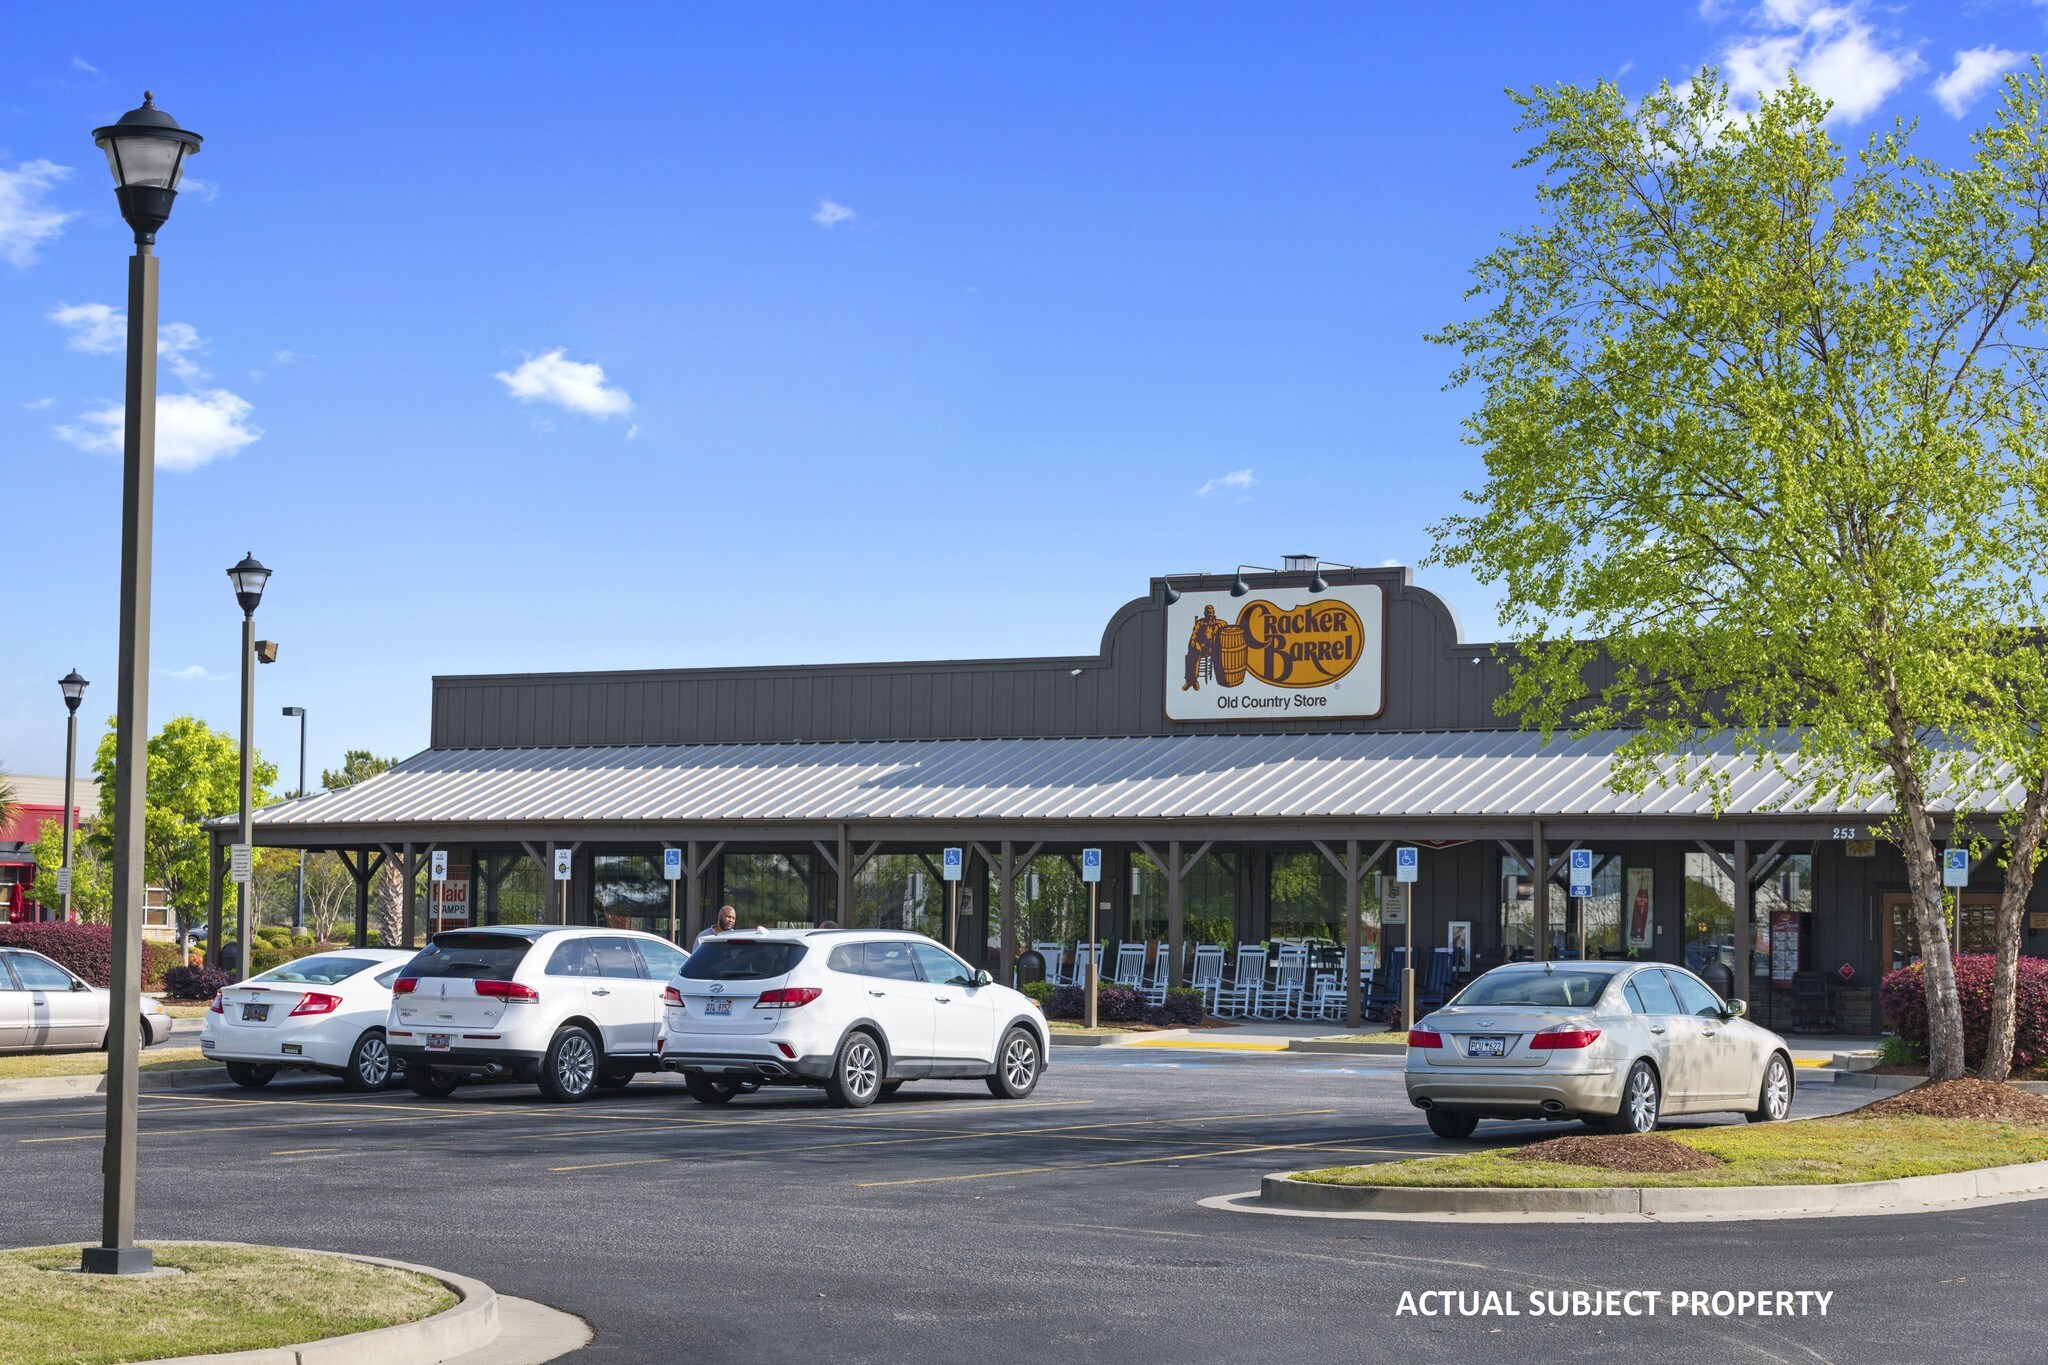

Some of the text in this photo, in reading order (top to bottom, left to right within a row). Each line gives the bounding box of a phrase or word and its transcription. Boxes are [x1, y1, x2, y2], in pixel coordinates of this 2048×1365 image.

[1241, 603, 1348, 649] Cracker
[1263, 634, 1352, 683] Barrel
[1217, 694, 1327, 710] Old Country Store
[1833, 828, 1855, 839] 253
[433, 904, 466, 914] SAMPS
